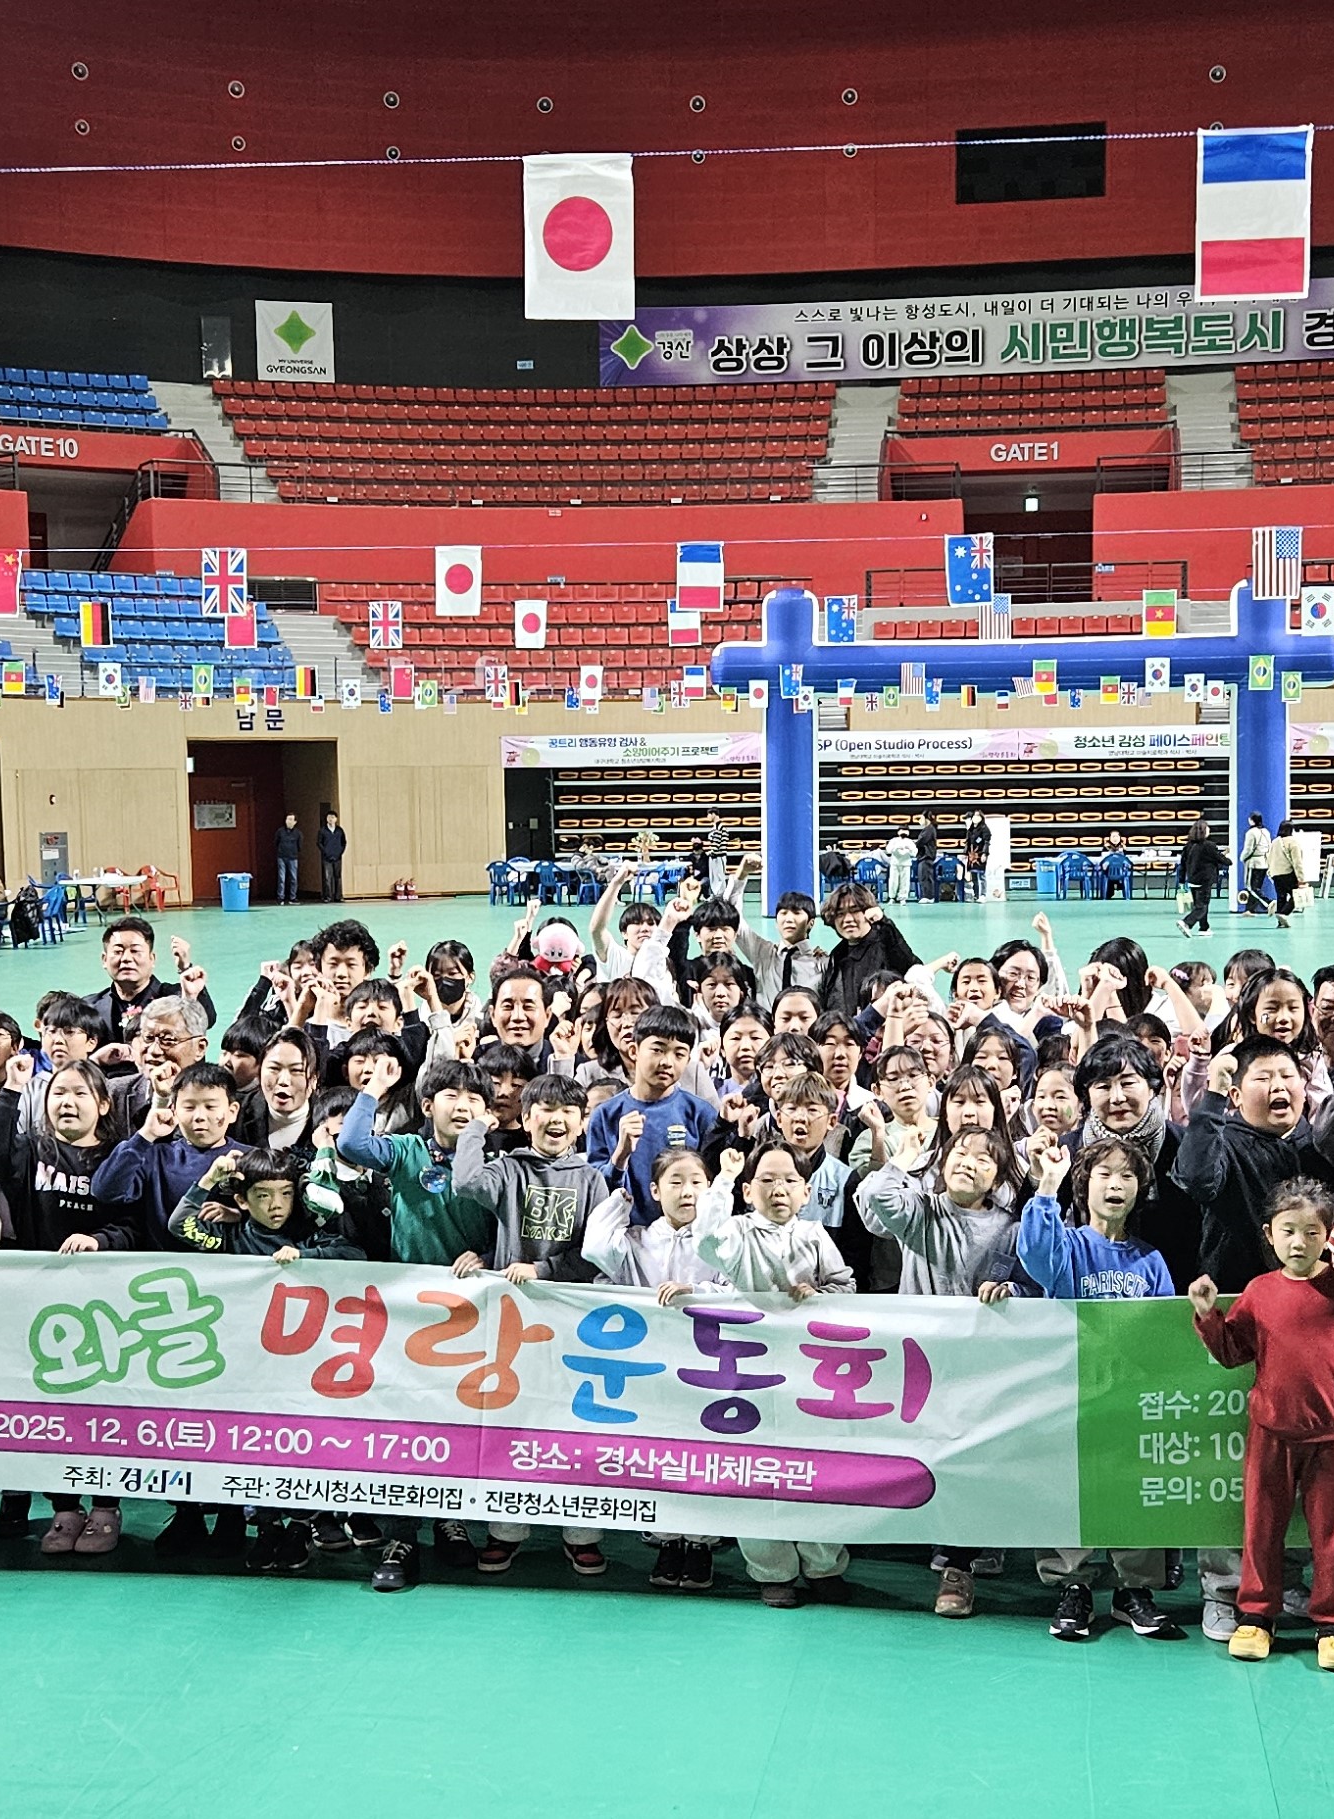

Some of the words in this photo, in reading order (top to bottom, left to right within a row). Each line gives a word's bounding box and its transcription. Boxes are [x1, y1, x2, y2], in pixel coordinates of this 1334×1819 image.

[795, 307, 842, 323] 스스로
[850, 305, 896, 322] 빛나는
[905, 301, 976, 320] 항성도시,
[984, 299, 1032, 317] 내일이
[1041, 298, 1054, 313] 더
[1063, 294, 1129, 312] 기대되는
[1137, 291, 1168, 308] 나의
[657, 340, 691, 360] 경산
[711, 337, 790, 373] 상상
[805, 333, 844, 370] 그
[862, 325, 982, 368] 이상의
[1001, 309, 1284, 364] 시민행복도시
[266, 365, 327, 375] GYEONGSAN
[990, 442, 1060, 462] GATE1
[640, 737, 647, 746] &
[835, 739, 871, 753] (Open
[874, 738, 915, 750] Studio
[917, 737, 972, 750] Process)
[1074, 734, 1115, 748] 청소년
[1118, 734, 1145, 748] 감성
[59, 1199, 93, 1211] PEACH
[29, 1268, 225, 1394] 와글
[1138, 1390, 1200, 1420] 접수:
[86, 1417, 128, 1446] 12.
[137, 1419, 216, 1451] 6.(토)
[228, 1425, 313, 1455] 12:00
[363, 1434, 450, 1463] 17:00
[1139, 1431, 1200, 1465] 대상:
[63, 1465, 112, 1489] 주최:
[118, 1466, 192, 1496] 경산시
[509, 1440, 583, 1472] 장소:
[595, 1446, 817, 1493] 경산실내체육관
[222, 1475, 271, 1499] 주관:
[274, 1478, 464, 1511] 경산시청소년문화의집
[484, 1490, 658, 1523] 진량청소년문화의집
[1139, 1476, 1202, 1507] 문의:
